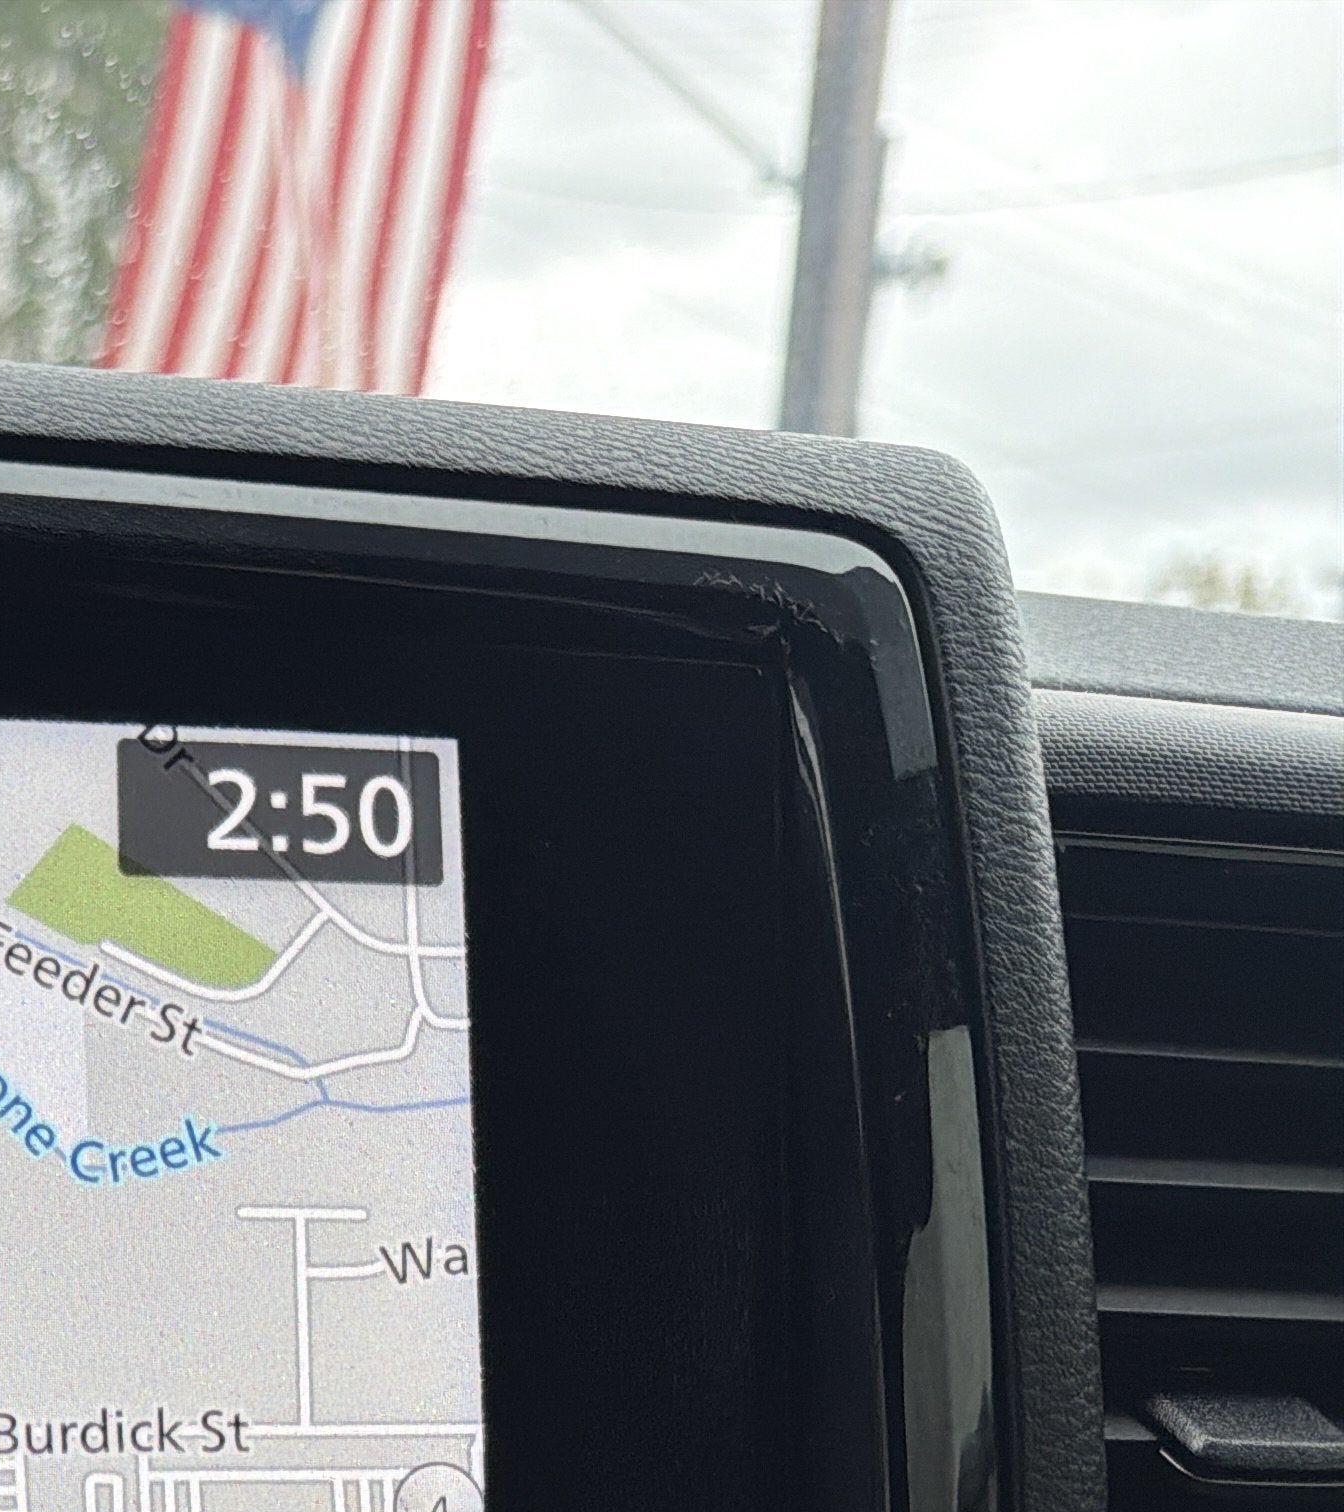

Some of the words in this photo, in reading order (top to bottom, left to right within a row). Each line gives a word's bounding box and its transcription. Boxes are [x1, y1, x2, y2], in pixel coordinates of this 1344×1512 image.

[206, 769, 413, 857] 2:50
[151, 1009, 205, 1055] St
[69, 1117, 222, 1183] Creek
[201, 1410, 250, 1454] St
